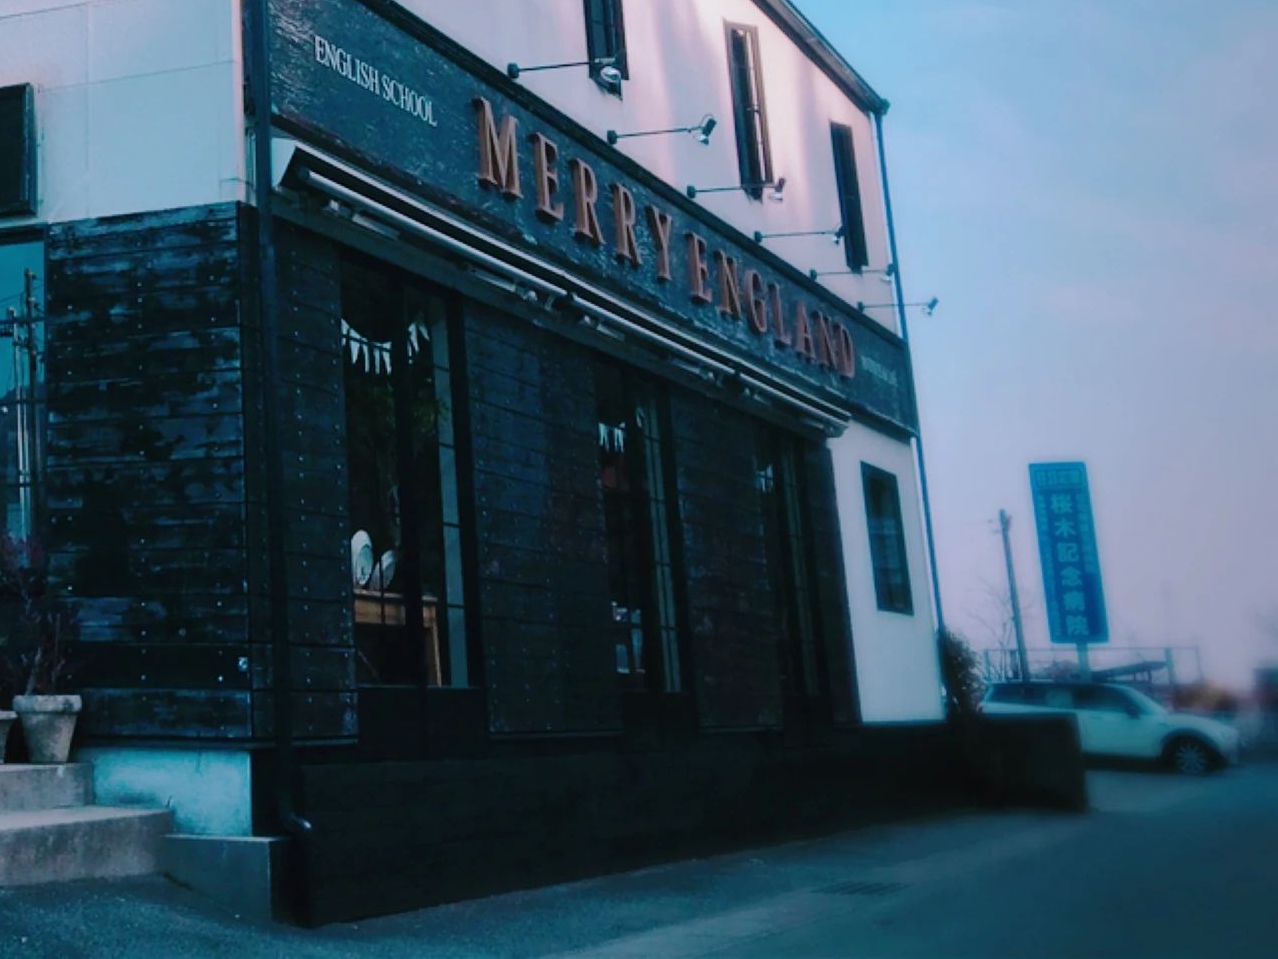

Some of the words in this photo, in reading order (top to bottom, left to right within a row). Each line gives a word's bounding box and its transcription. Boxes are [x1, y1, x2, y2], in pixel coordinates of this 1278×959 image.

[313, 35, 381, 95] ENGLISH
[381, 74, 438, 127] SCHOOL
[472, 95, 675, 283] MERRY
[684, 230, 858, 380] ENGLAND
